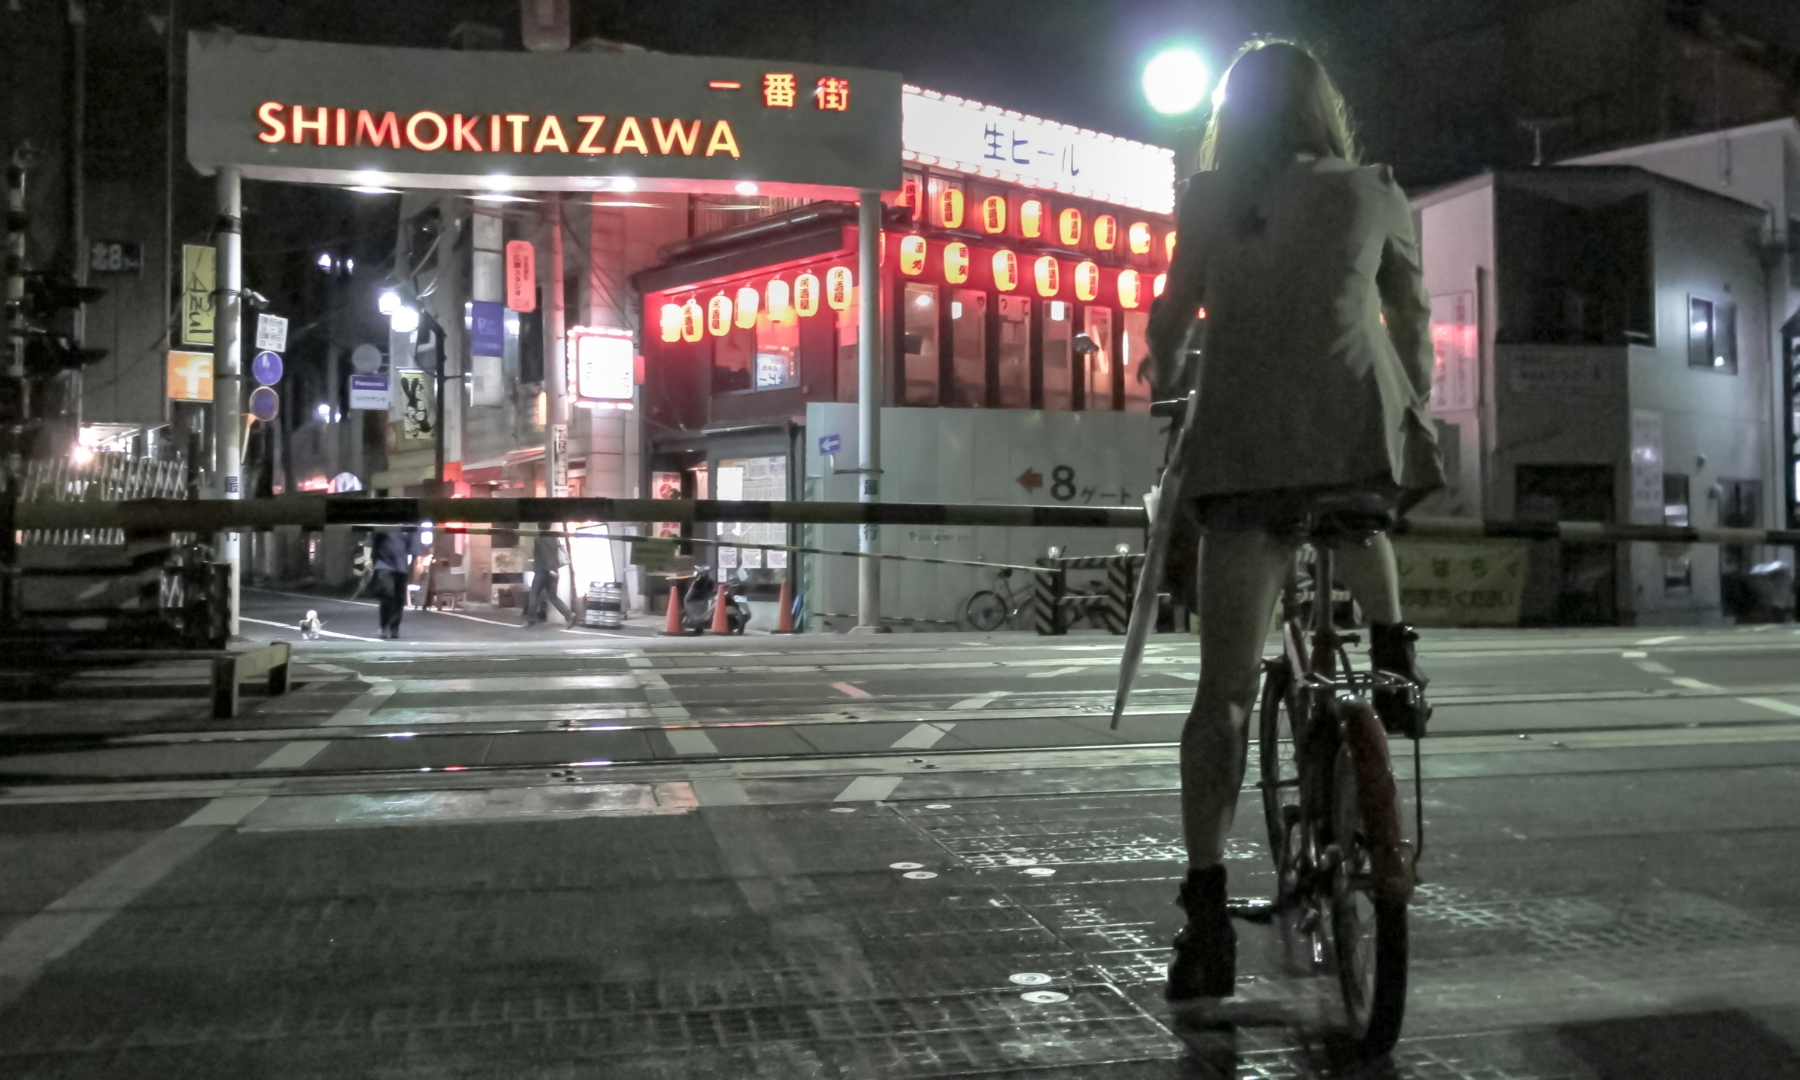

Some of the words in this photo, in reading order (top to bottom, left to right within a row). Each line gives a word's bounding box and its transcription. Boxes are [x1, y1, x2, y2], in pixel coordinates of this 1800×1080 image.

[709, 73, 848, 111] 一番街
[258, 101, 741, 159] SHIMOKITAZAWA
